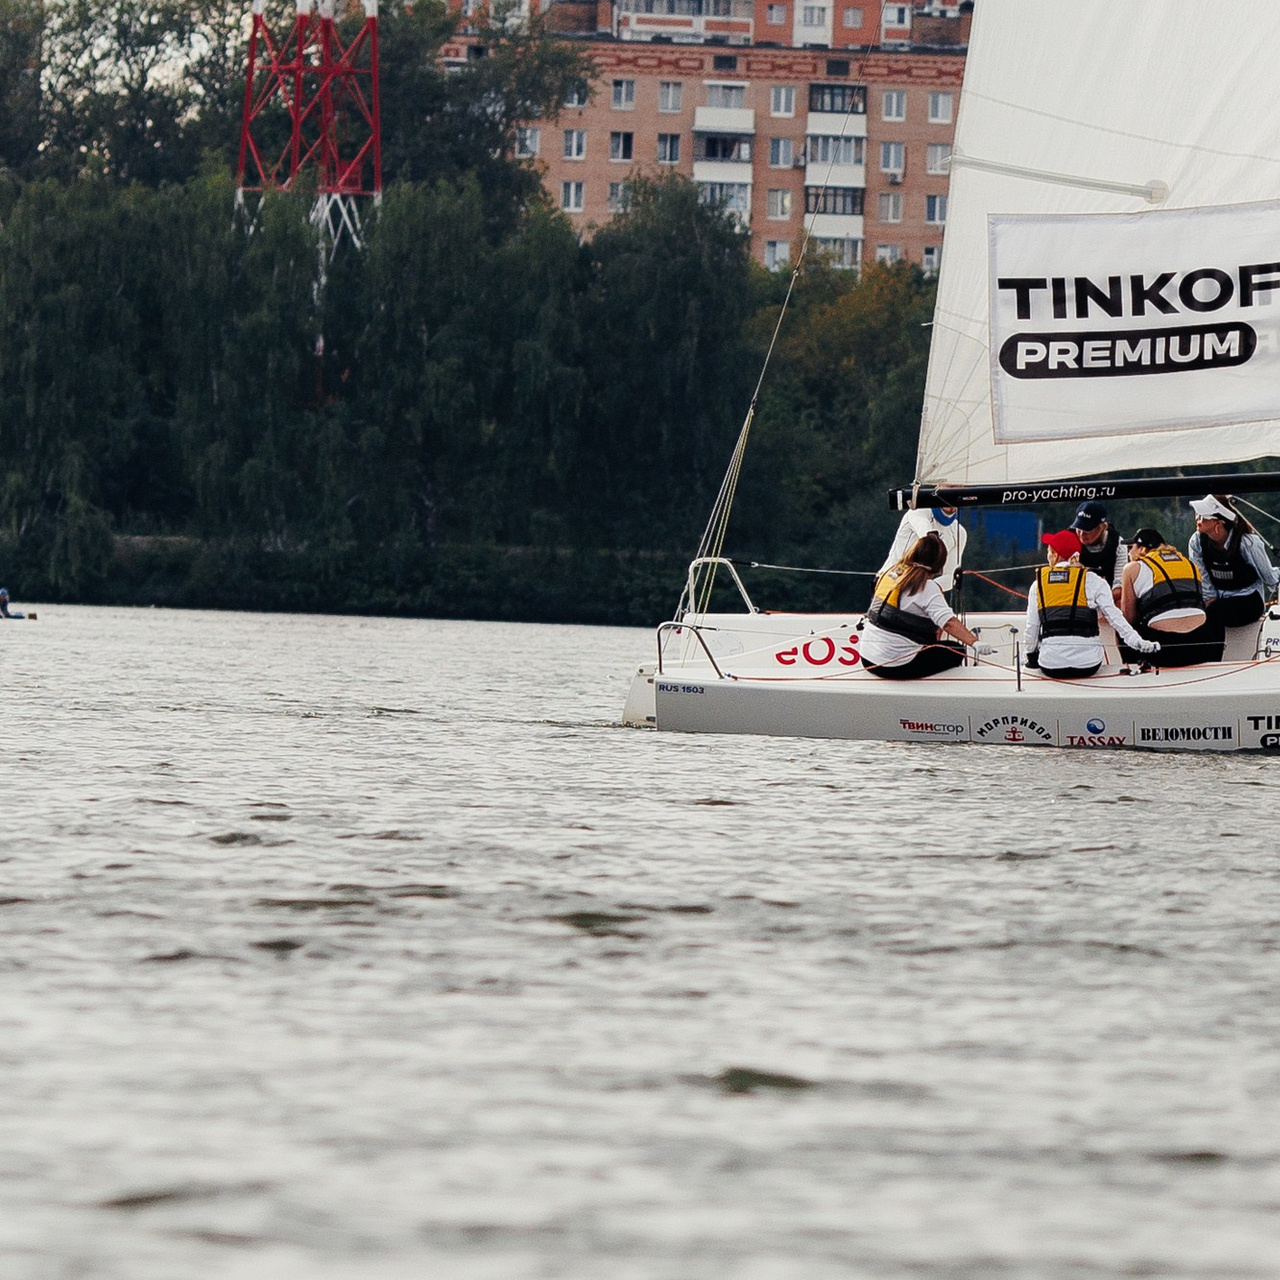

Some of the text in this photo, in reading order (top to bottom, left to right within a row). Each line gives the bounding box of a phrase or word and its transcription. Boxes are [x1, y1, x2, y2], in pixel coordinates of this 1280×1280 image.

[1015, 330, 1240, 370] PREMIUM
[1001, 485, 1116, 503] pro-yachting.ru
[658, 684, 705, 694] RUS 1503
[976, 716, 1052, 741] МОРПРИБОР
[1140, 726, 1232, 742] ВЕДОМОСТИ
[1066, 735, 1127, 747] TASSAY
